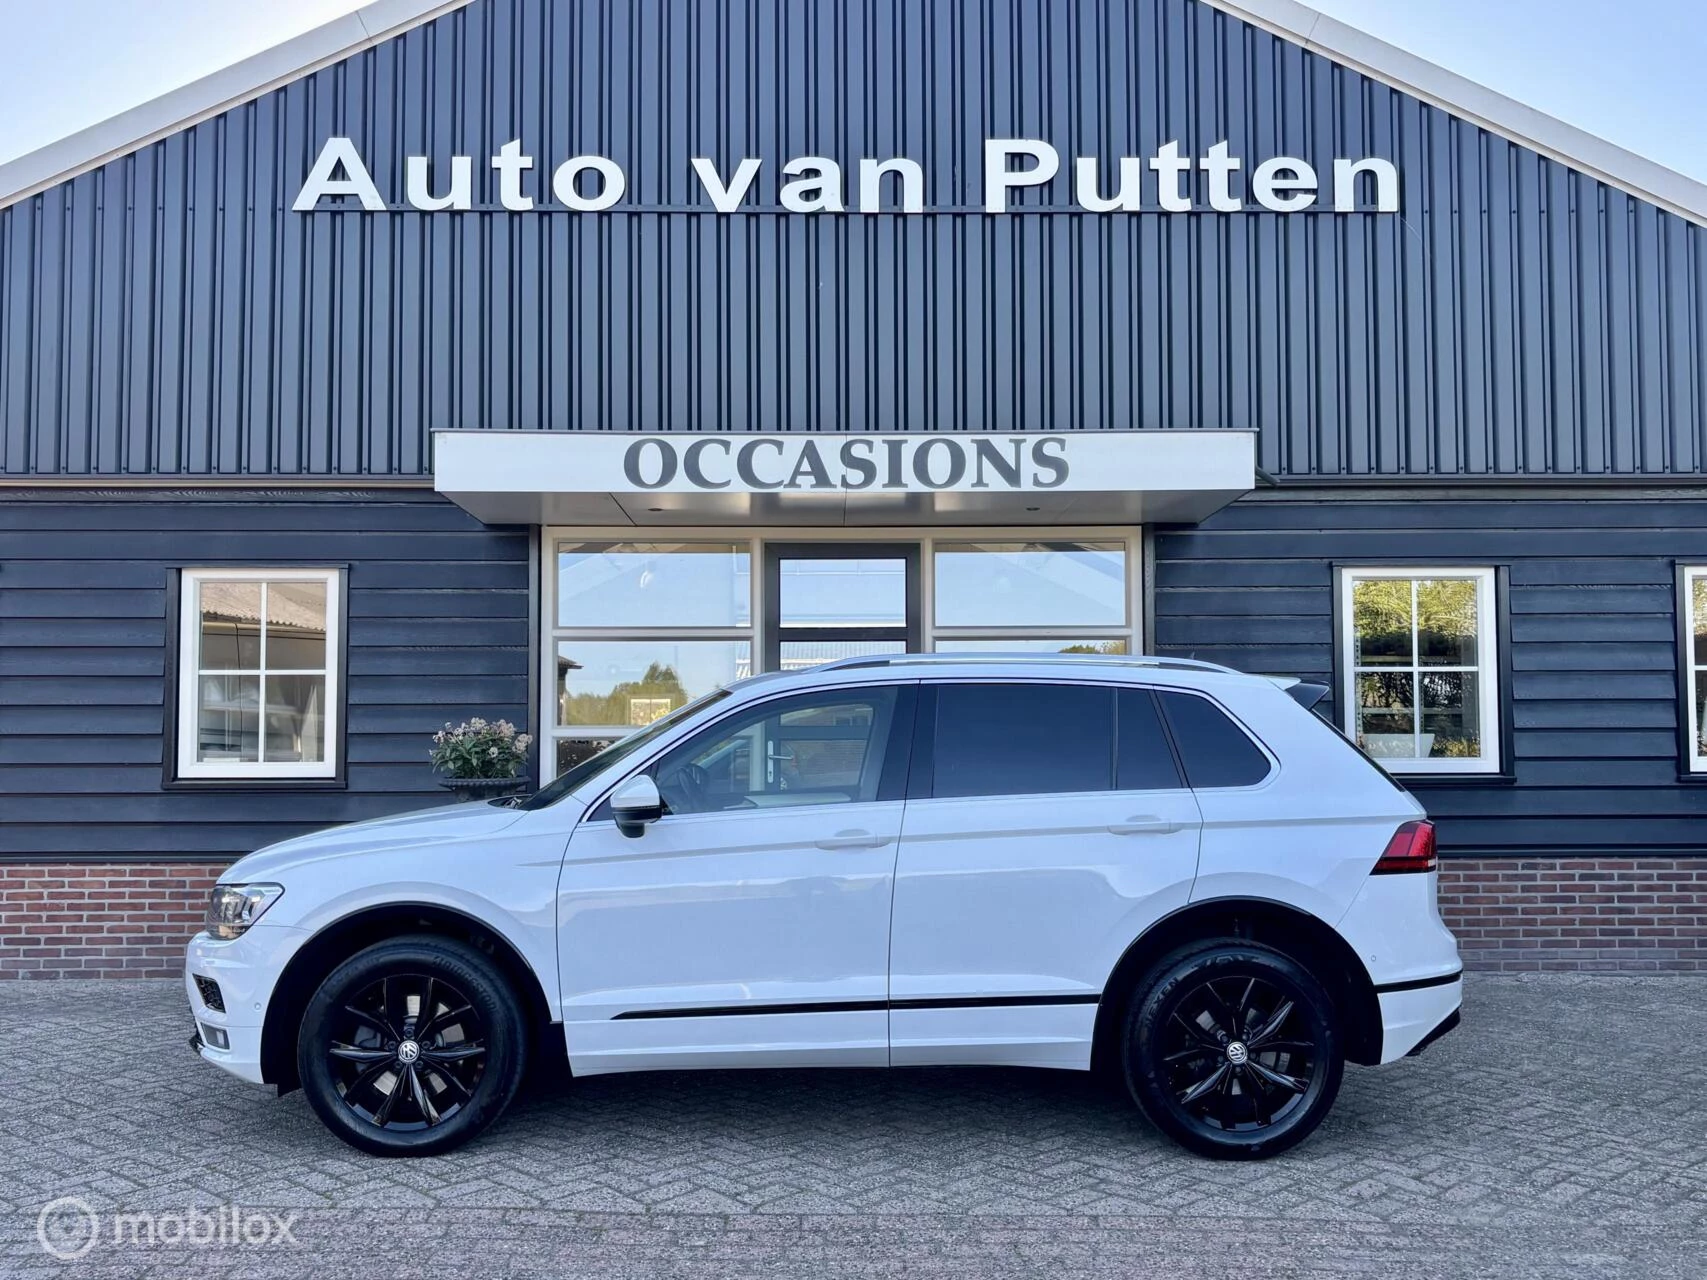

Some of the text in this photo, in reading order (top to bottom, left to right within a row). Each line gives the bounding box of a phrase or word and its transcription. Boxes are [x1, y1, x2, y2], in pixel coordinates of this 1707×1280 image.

[292, 137, 1399, 214] Auto van Putten
[623, 437, 1070, 489] OCCASIONS
